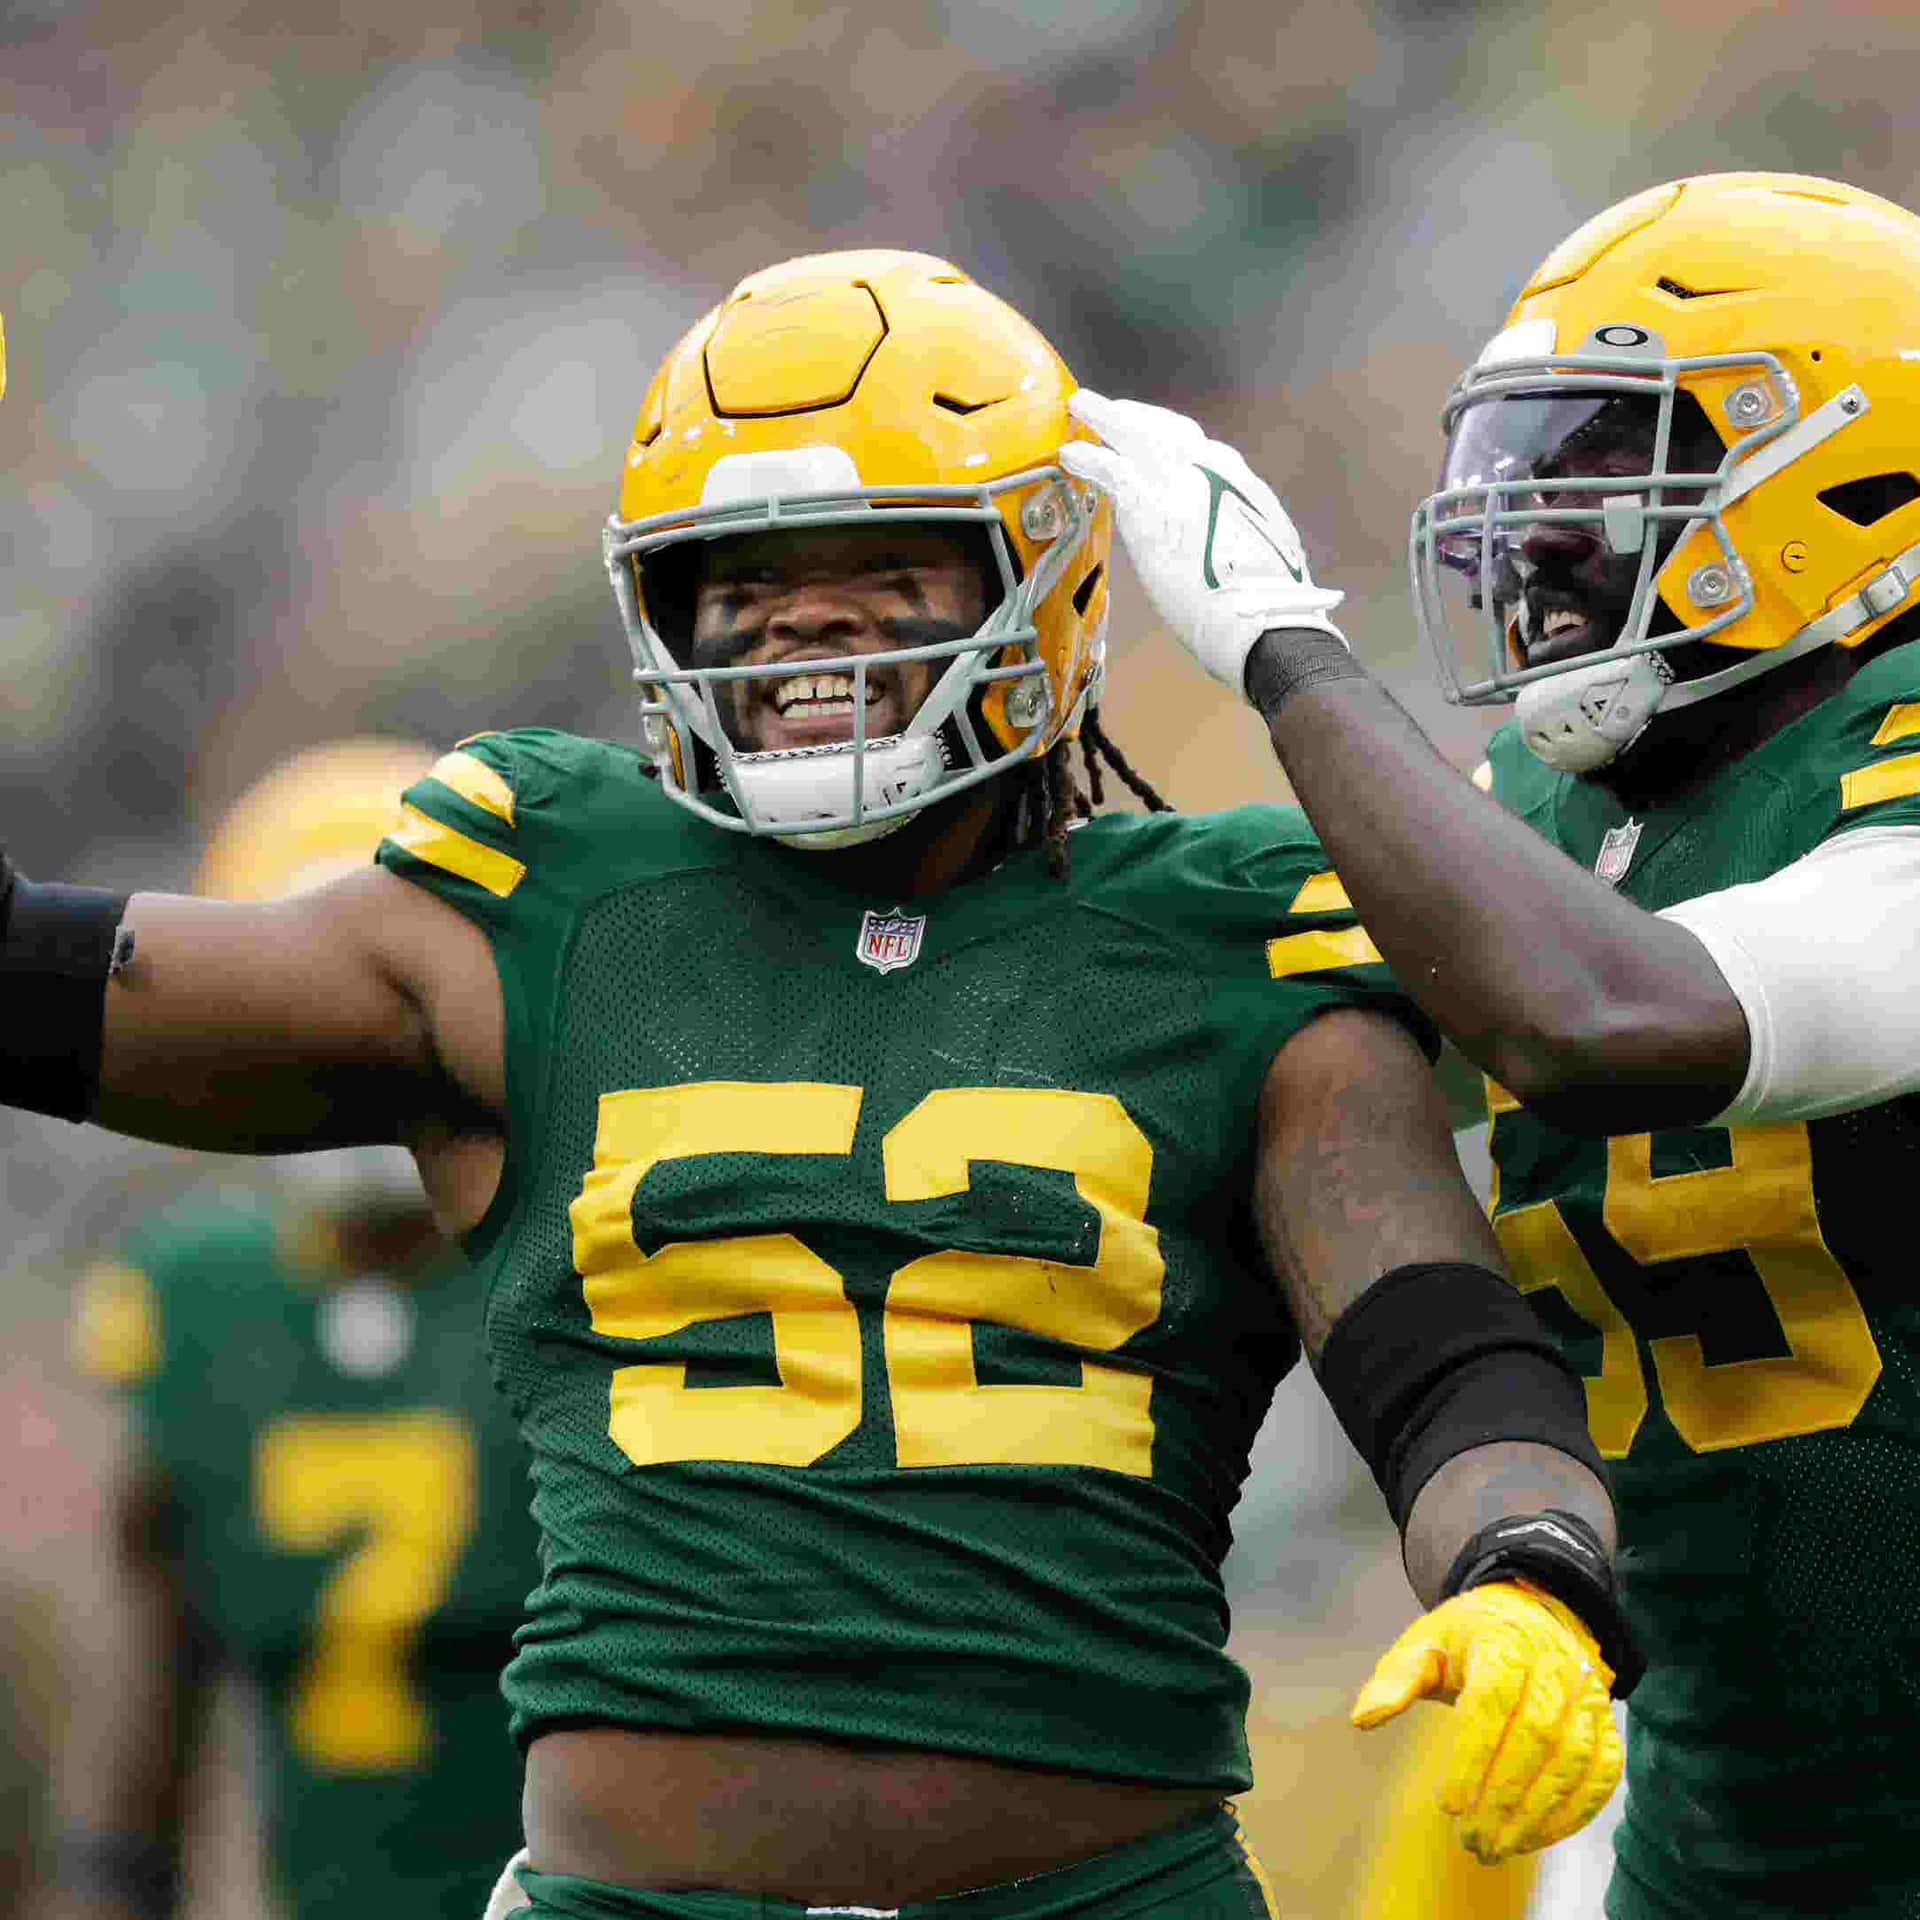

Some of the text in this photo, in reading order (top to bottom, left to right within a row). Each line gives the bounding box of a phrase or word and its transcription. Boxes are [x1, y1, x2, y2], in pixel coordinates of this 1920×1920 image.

[868, 934, 907, 960] NFL
[569, 1080, 1167, 1479] 52
[253, 1411, 477, 1772] 7
